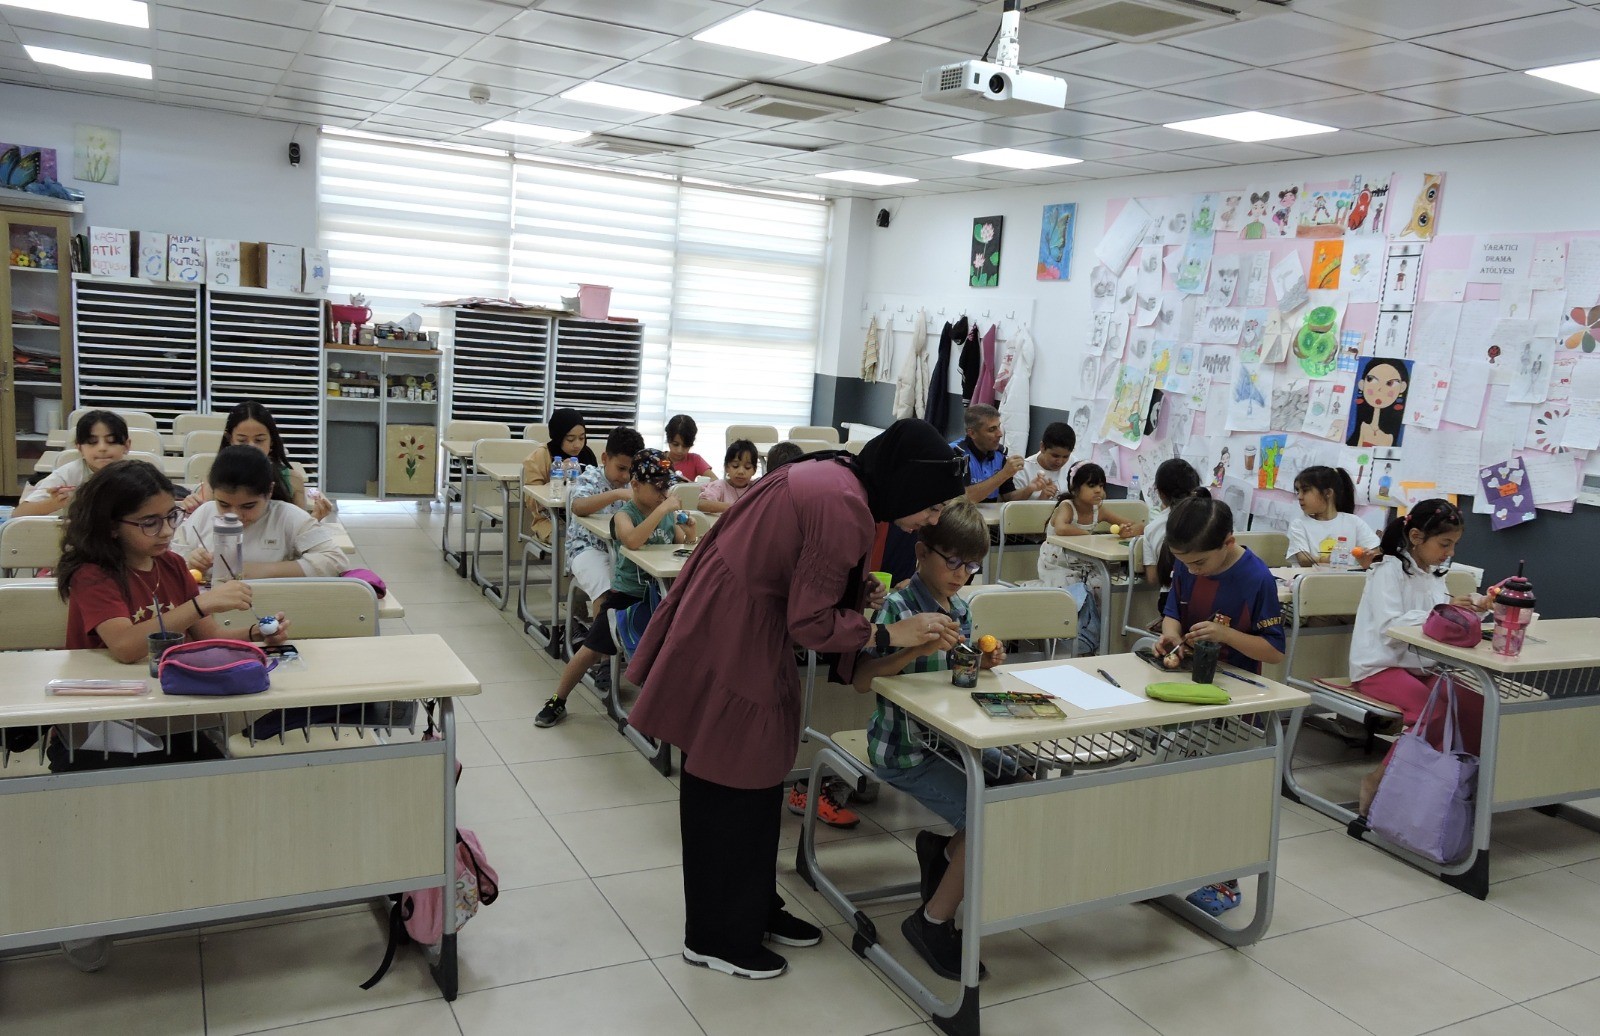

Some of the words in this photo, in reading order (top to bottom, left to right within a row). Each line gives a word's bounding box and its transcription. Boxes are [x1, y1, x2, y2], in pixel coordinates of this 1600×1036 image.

[170, 235, 200, 244] METAL
[92, 244, 121, 256] ATIK
[1484, 243, 1518, 251] YARATICI
